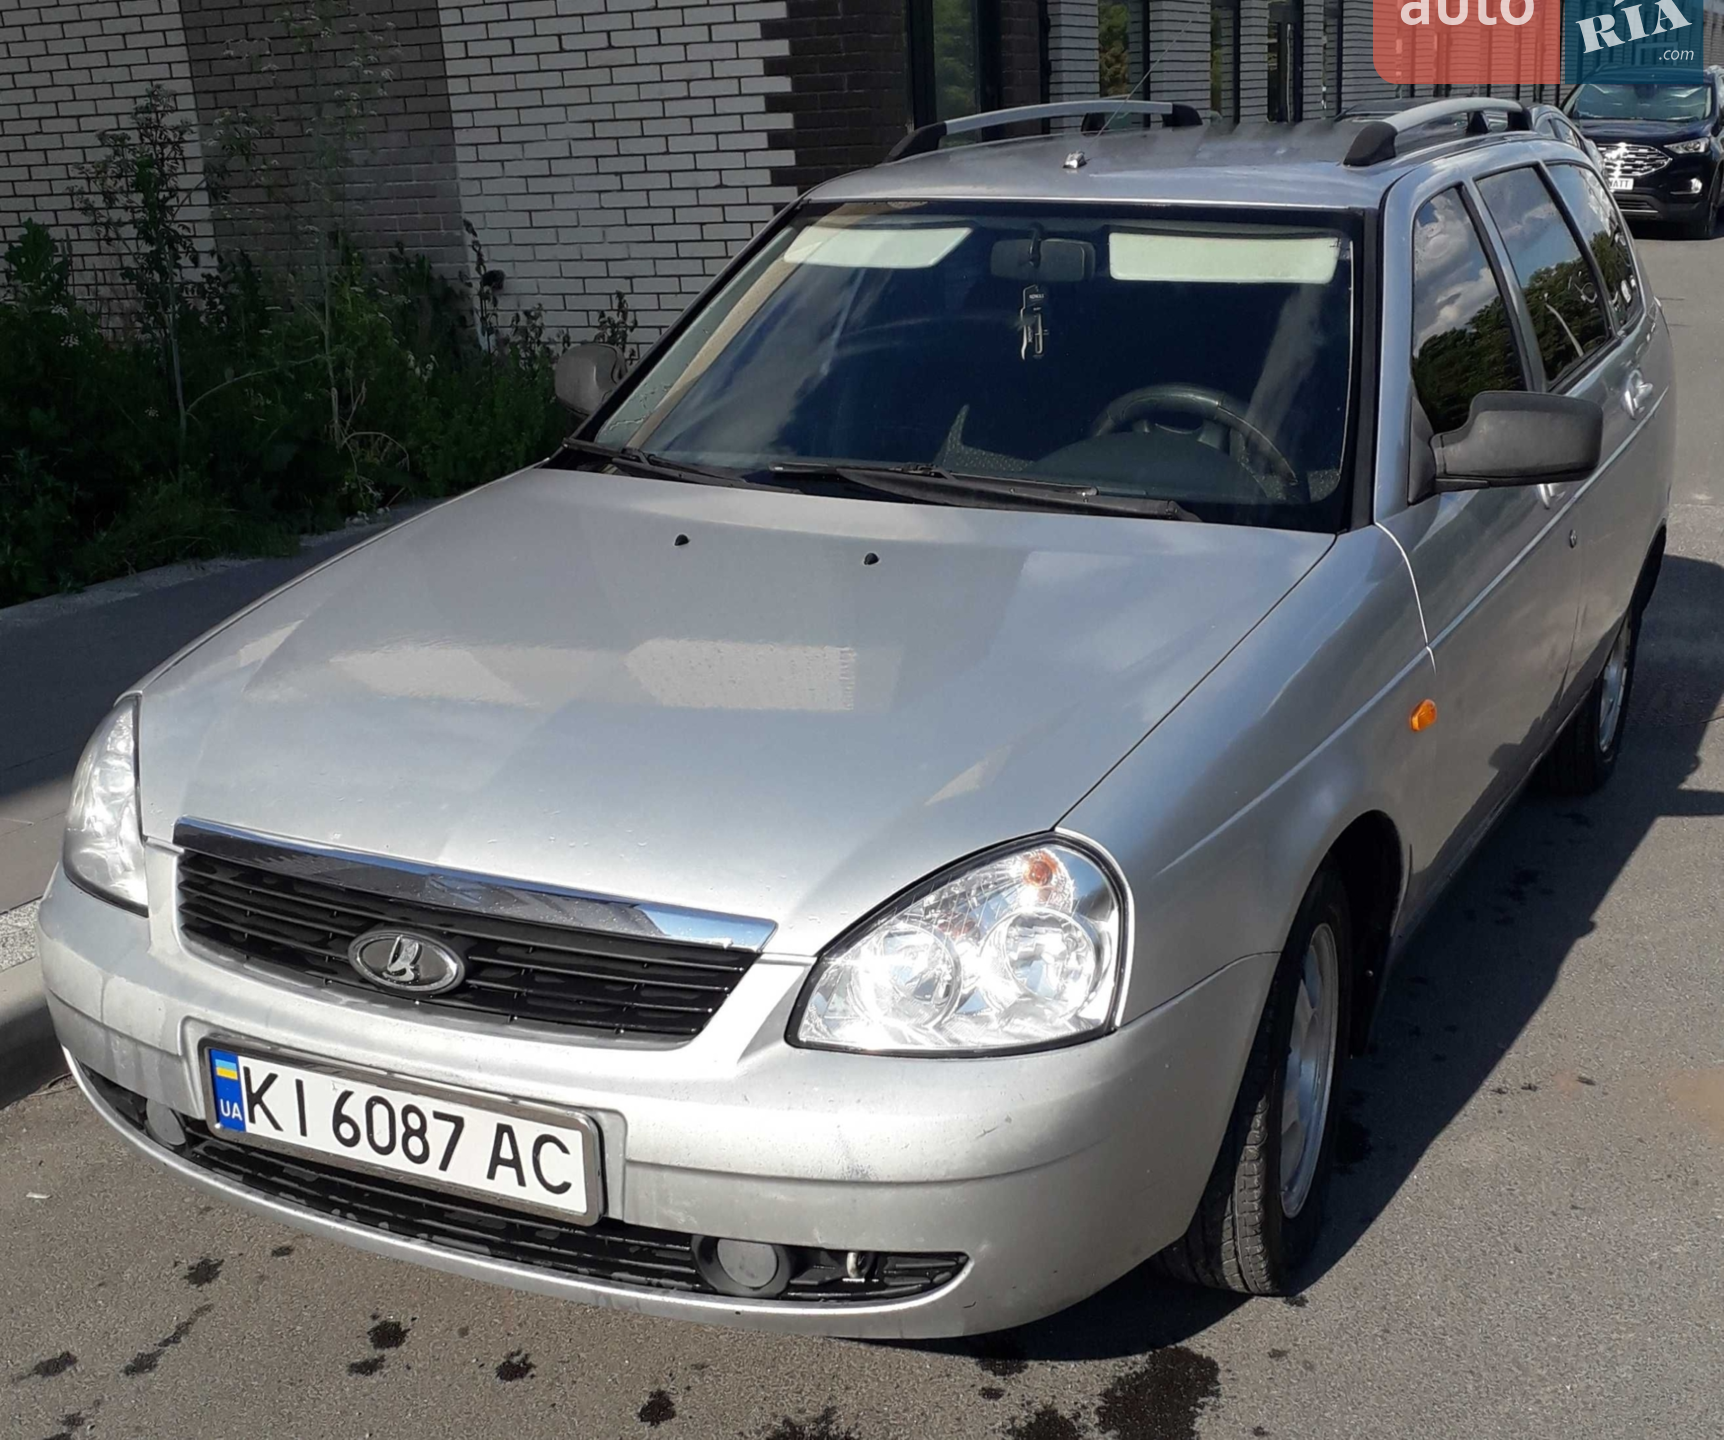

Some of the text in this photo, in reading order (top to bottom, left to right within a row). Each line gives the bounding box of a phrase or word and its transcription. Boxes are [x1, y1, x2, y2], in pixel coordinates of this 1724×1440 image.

[219, 1098, 243, 1122] UA
[242, 1065, 573, 1195] KI 6087 AC
